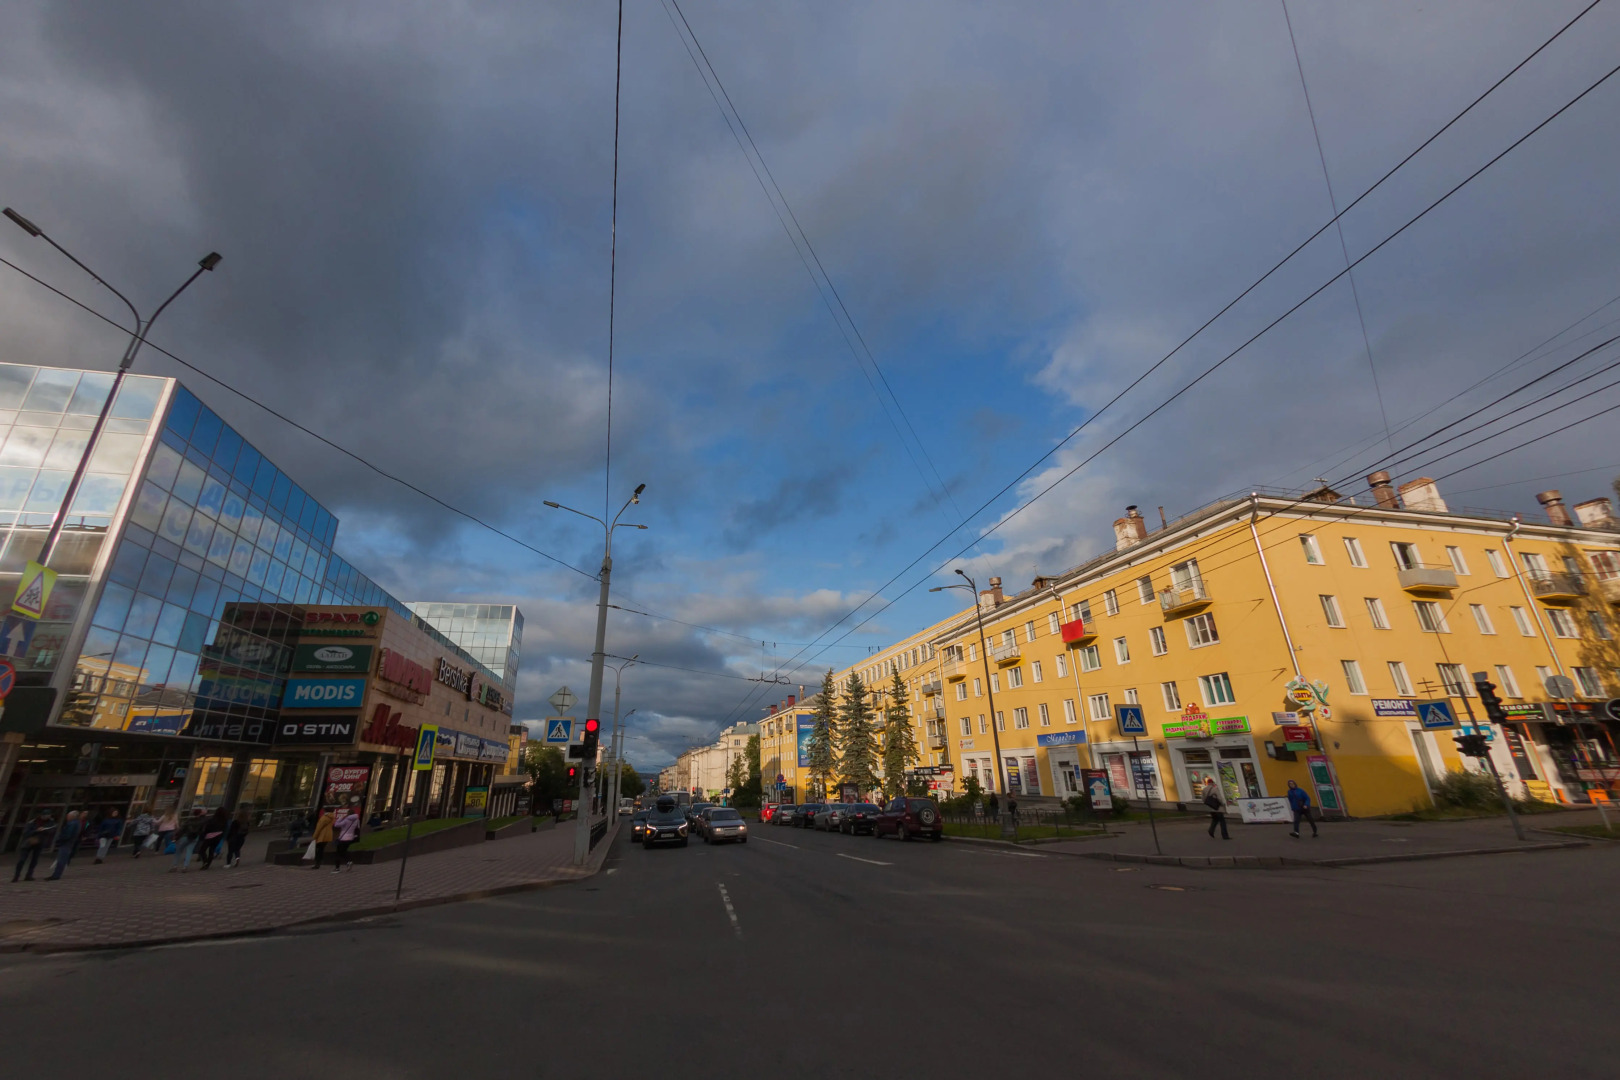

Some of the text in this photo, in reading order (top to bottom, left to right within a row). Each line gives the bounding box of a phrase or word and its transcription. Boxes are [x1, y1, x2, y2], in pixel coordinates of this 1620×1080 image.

[306, 612, 361, 622] SPAR
[439, 657, 470, 694] Bershka
[294, 684, 356, 701] MODIS
[1372, 700, 1408, 710] РЕМОНТ
[1181, 713, 1207, 722] ПОДАРКИ
